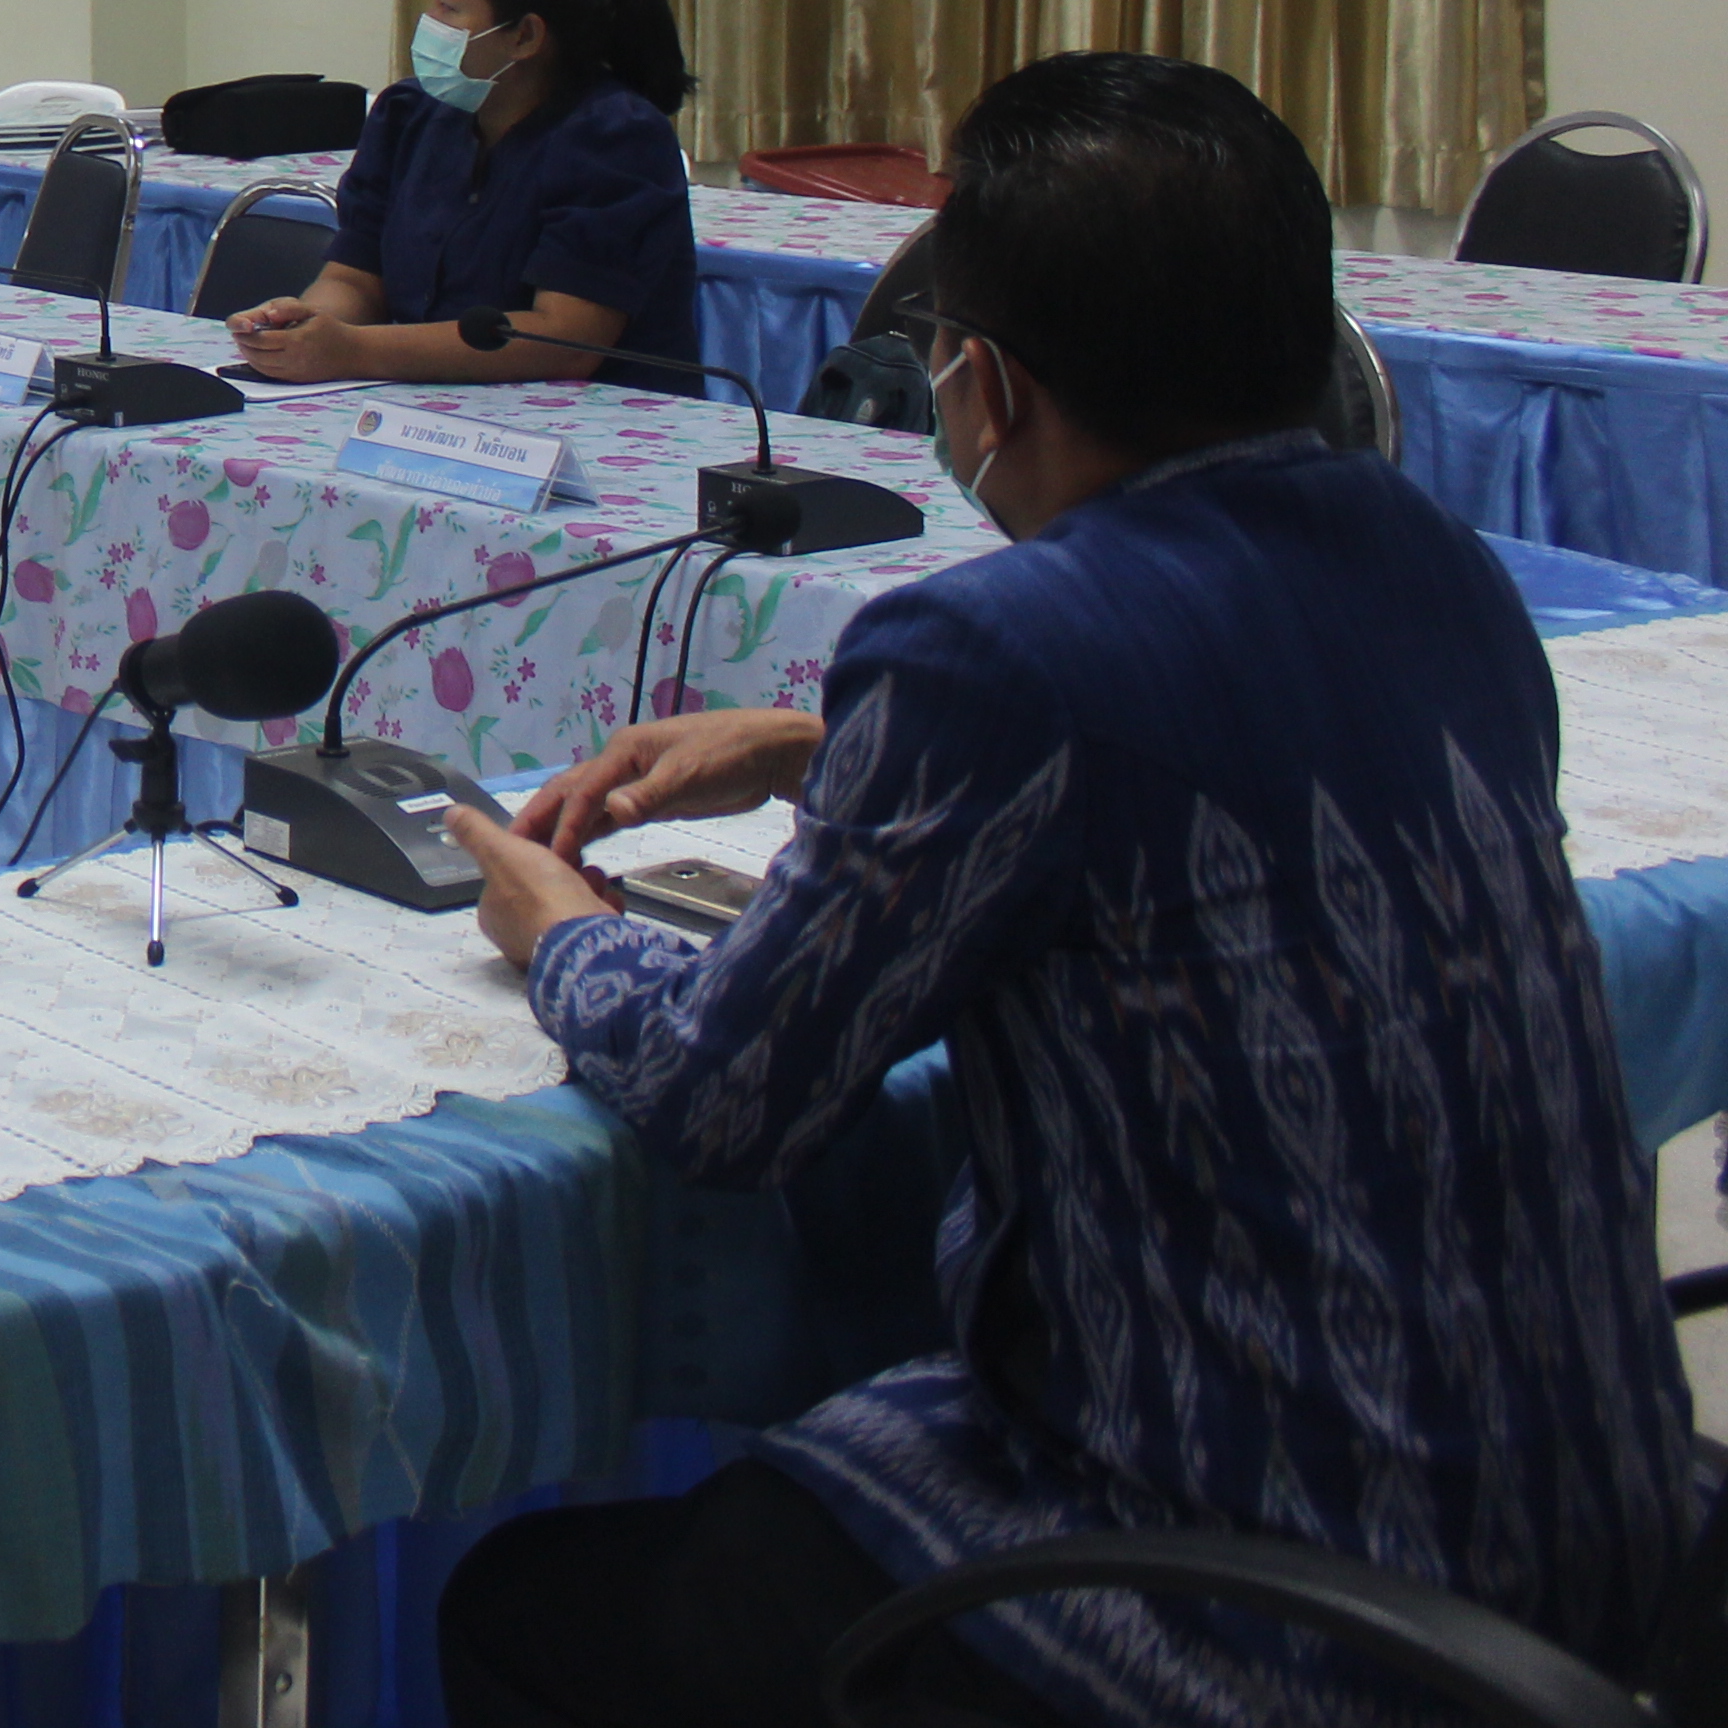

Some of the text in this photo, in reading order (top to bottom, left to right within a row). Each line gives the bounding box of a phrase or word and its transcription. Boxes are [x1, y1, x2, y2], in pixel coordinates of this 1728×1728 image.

[77, 367, 110, 382] HONIC
[400, 424, 466, 449] นายพัฒนา
